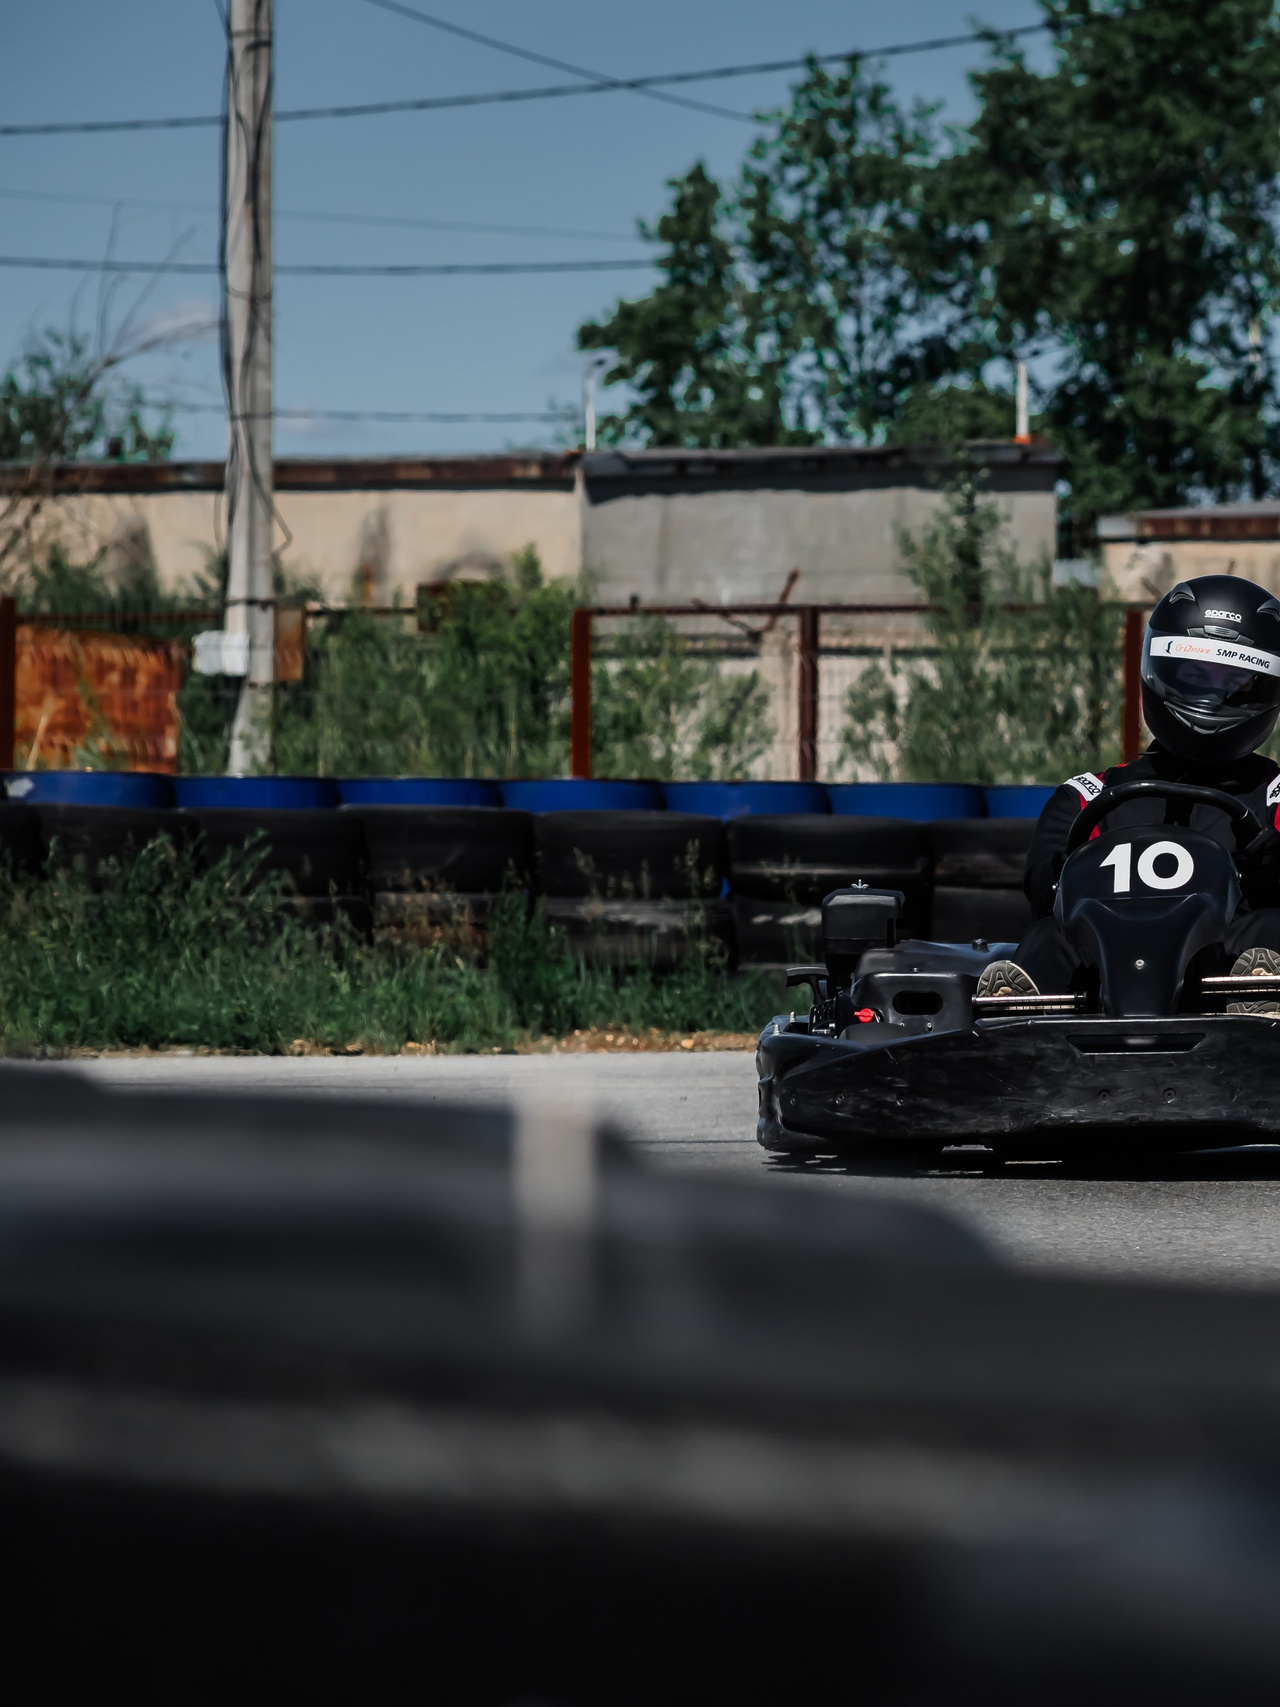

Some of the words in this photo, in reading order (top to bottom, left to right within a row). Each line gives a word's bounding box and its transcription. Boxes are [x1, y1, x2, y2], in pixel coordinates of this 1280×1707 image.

[1216, 648, 1238, 659] SMP
[1239, 653, 1271, 669] RACING
[1099, 841, 1194, 893] 10
